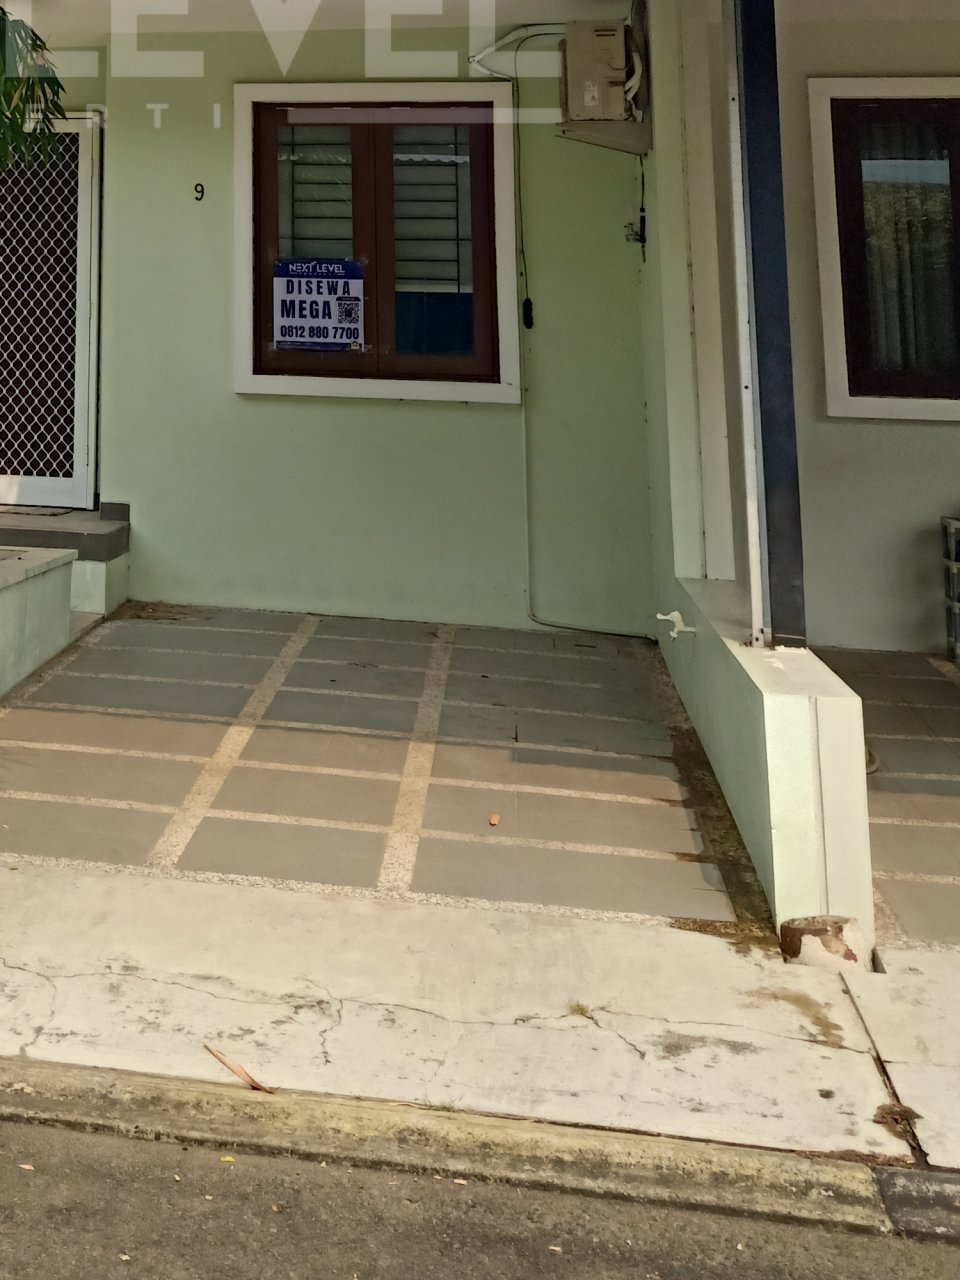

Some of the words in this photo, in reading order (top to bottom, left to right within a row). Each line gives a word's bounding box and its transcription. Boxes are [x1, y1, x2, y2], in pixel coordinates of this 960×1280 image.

[194, 183, 205, 201] 9
[289, 262, 315, 272] NEXT
[317, 264, 345, 272] LEVEL
[286, 279, 351, 296] DISEWA
[280, 299, 332, 319] MEGA
[280, 325, 305, 338] 0812
[309, 326, 329, 339] 880
[332, 327, 360, 340] 7700
